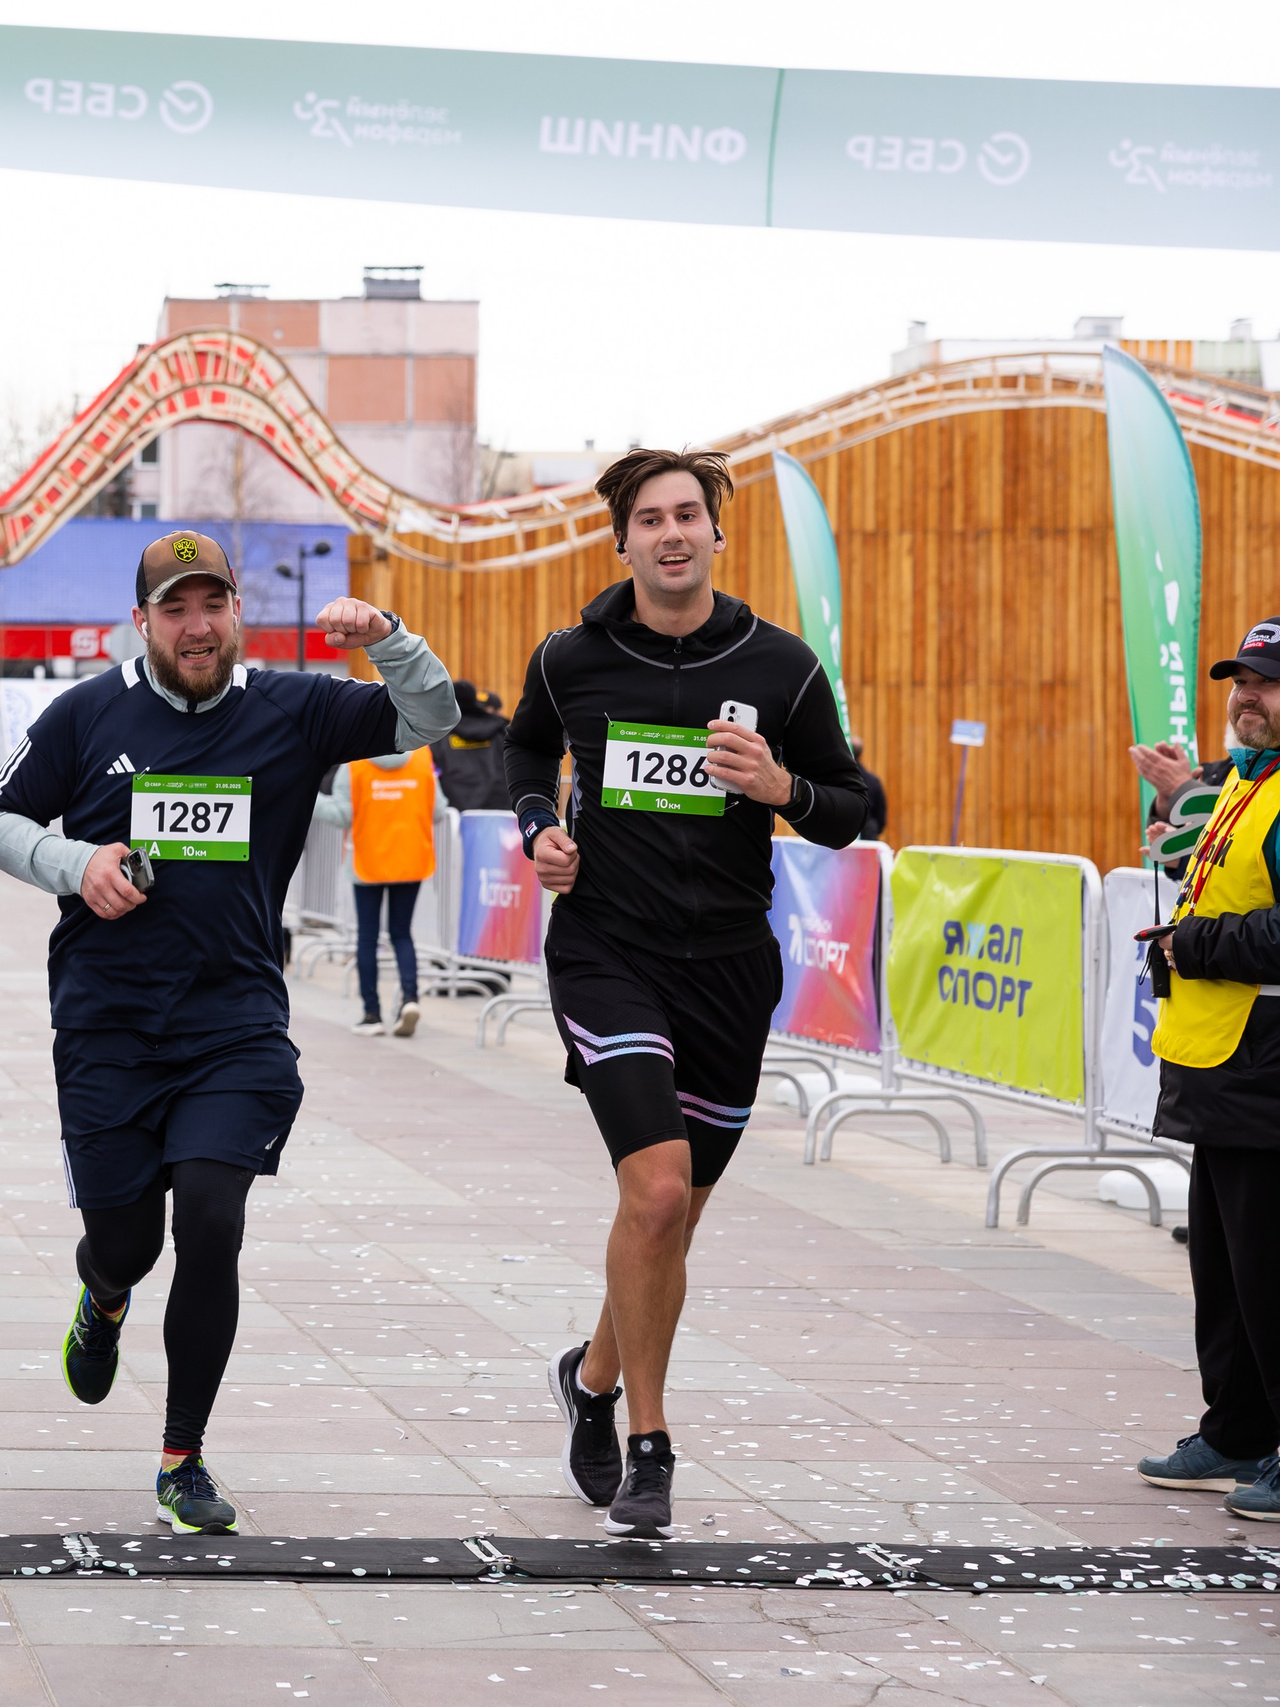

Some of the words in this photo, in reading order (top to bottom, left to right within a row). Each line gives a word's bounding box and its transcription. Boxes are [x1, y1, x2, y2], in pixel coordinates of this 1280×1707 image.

[626, 750, 710, 788] 1286
[152, 801, 234, 833] 1287
[938, 965, 1033, 1018] СПОРТ
